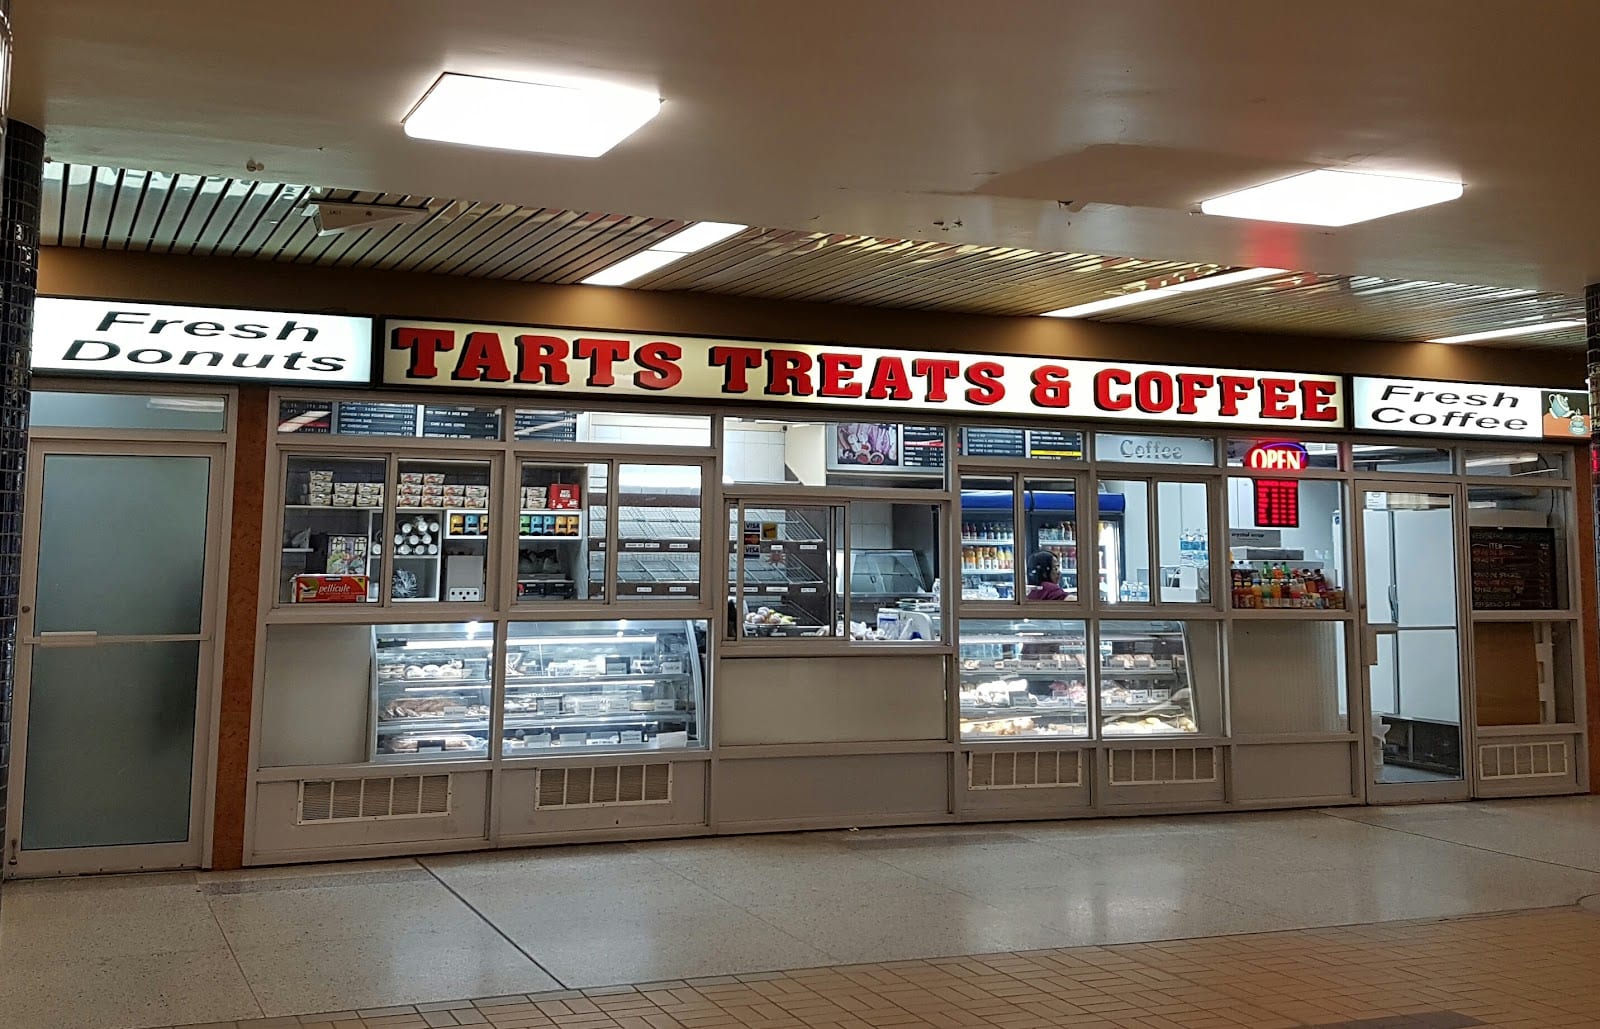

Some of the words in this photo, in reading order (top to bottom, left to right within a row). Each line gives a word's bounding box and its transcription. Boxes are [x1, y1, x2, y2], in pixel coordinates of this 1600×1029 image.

[95, 311, 320, 342] Fresh
[61, 339, 347, 372] Donuts
[392, 327, 683, 388] TARTS
[709, 346, 1005, 405] TREATS
[1030, 364, 1071, 408] &
[1093, 368, 1338, 421] COFFEE
[1380, 385, 1520, 408] Fresh
[1371, 407, 1528, 430] Coffee
[1120, 439, 1183, 459] Coffee
[1251, 448, 1301, 470] OPEN
[319, 584, 351, 593] pellicule
